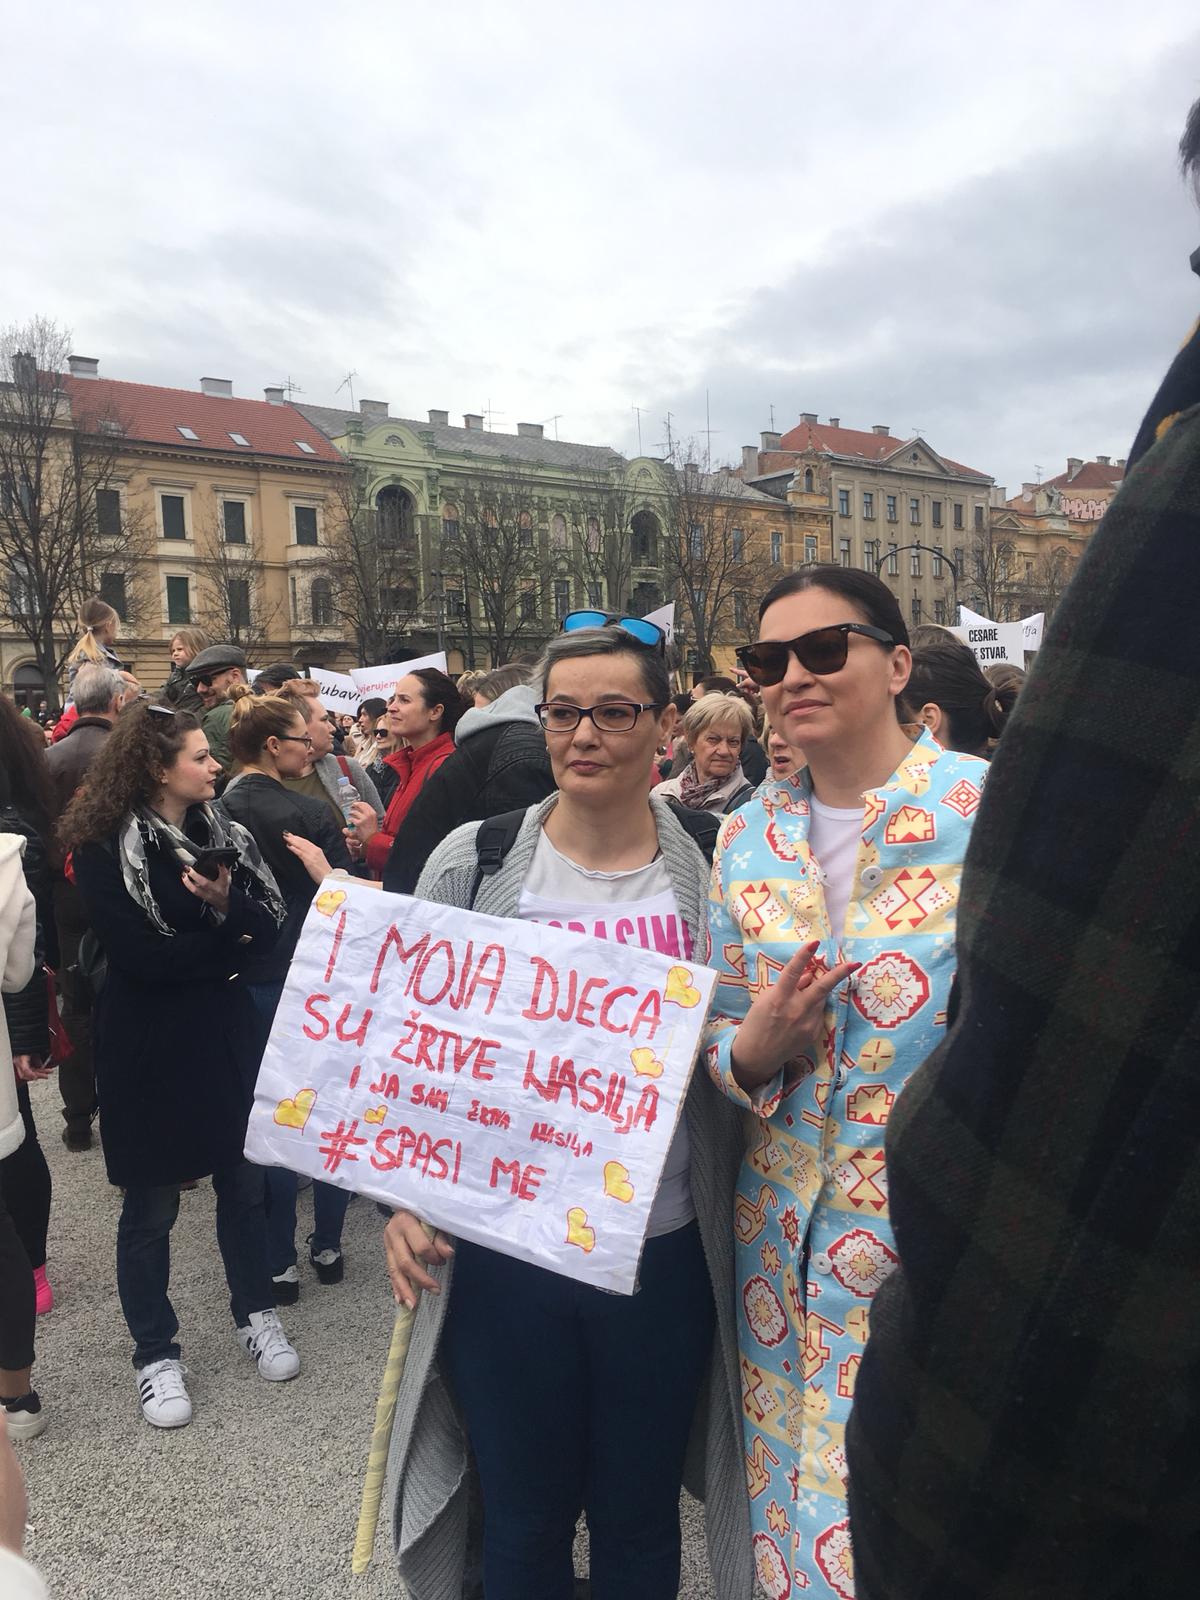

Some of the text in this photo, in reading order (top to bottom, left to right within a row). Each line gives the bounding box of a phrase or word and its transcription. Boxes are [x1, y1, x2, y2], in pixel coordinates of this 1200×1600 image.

[968, 628, 998, 642] CESARE
[980, 646, 1009, 660] STVAR,
[324, 911, 346, 983] I
[370, 924, 506, 1015] MOJA
[522, 956, 664, 1040] DJECA
[302, 993, 661, 1134] SU ŽRTVE NASILJA
[349, 1065, 361, 1090] I
[369, 1072, 400, 1099] JA
[318, 1119, 547, 1201] #SPASI ME
